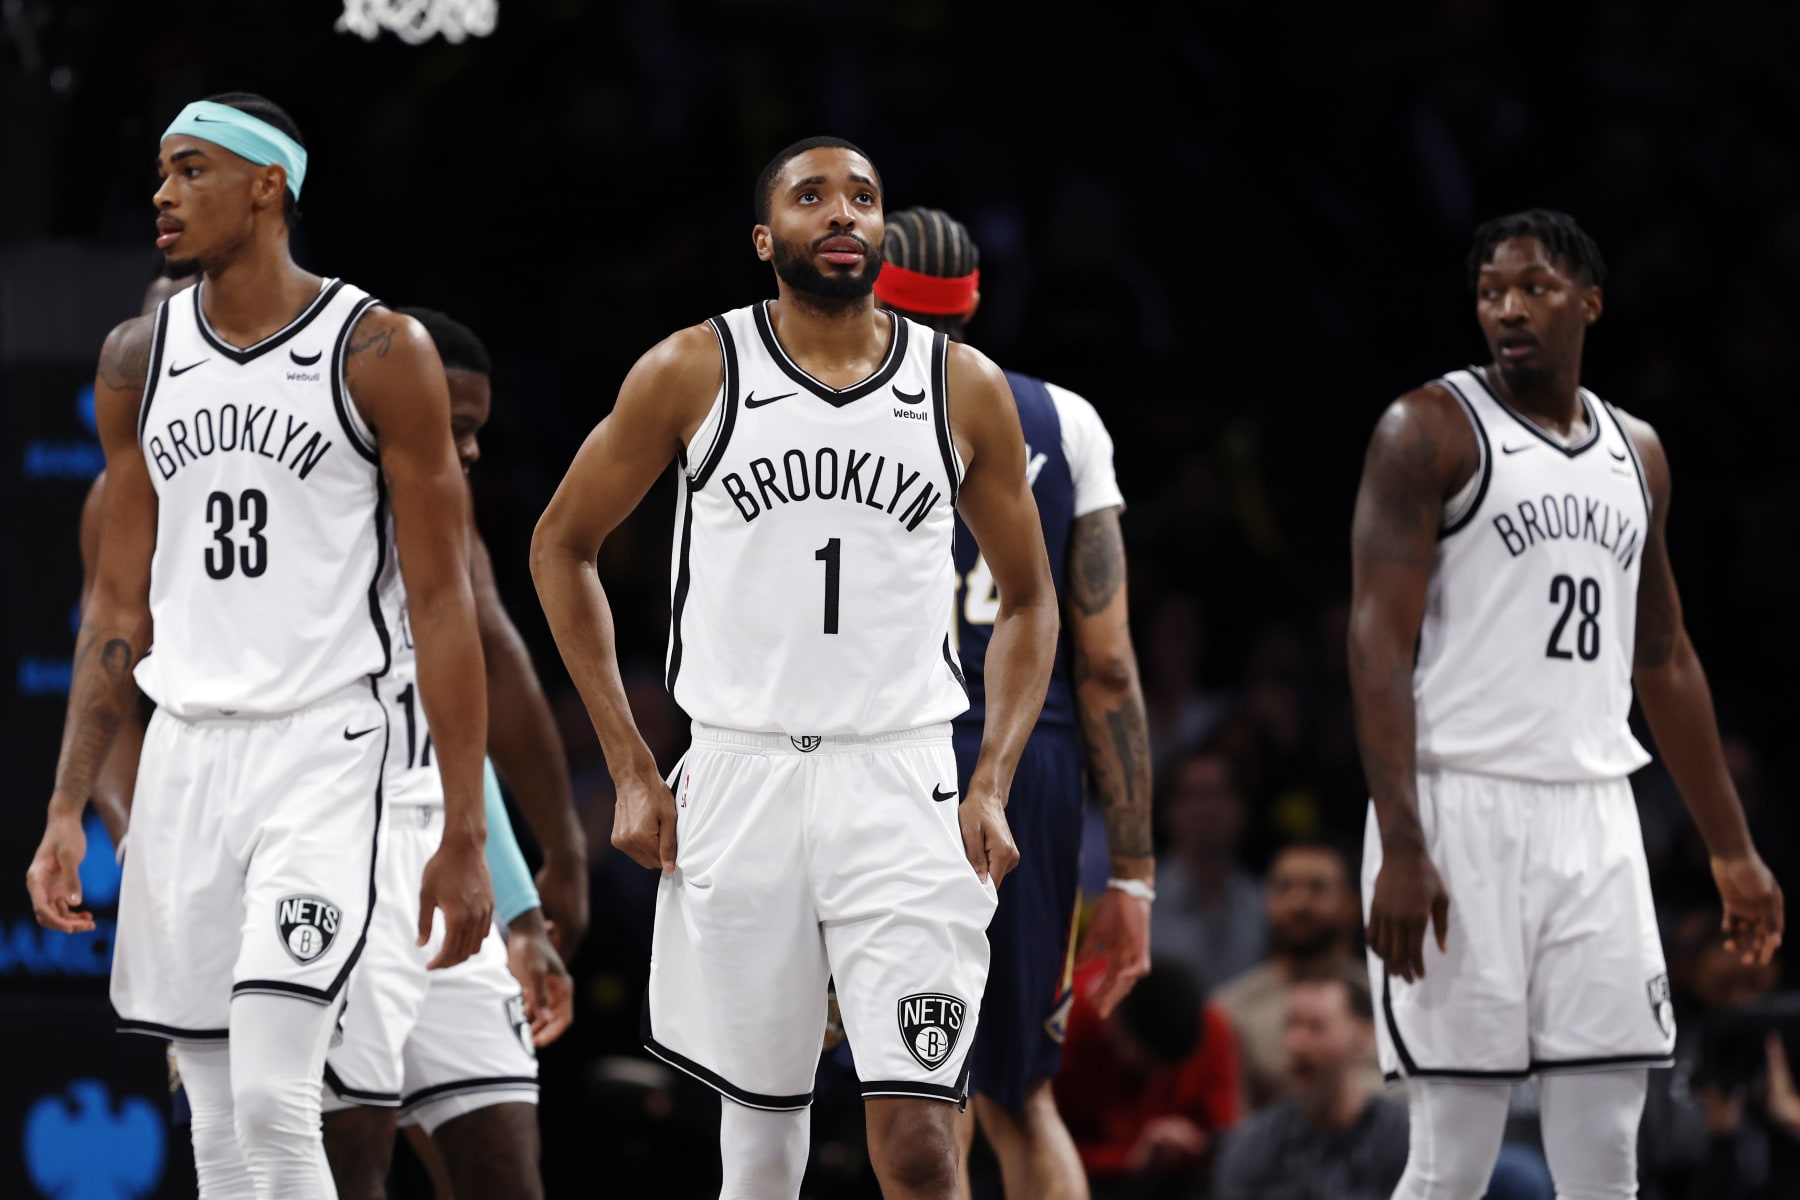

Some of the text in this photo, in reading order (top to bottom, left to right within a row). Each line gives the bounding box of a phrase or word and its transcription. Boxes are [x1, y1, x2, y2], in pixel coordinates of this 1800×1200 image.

[286, 372, 320, 382] Webull
[893, 407, 928, 421] Webull
[150, 404, 332, 480] BROOKLYN
[722, 447, 941, 532] BROOKLYN
[204, 488, 268, 579] 33
[1493, 494, 1639, 571] BROOKLYN
[814, 537, 842, 635] 1
[1545, 574, 1602, 662] 28
[280, 898, 339, 935] NETS
[903, 998, 962, 1030] NETS
[927, 1031, 939, 1057] B
